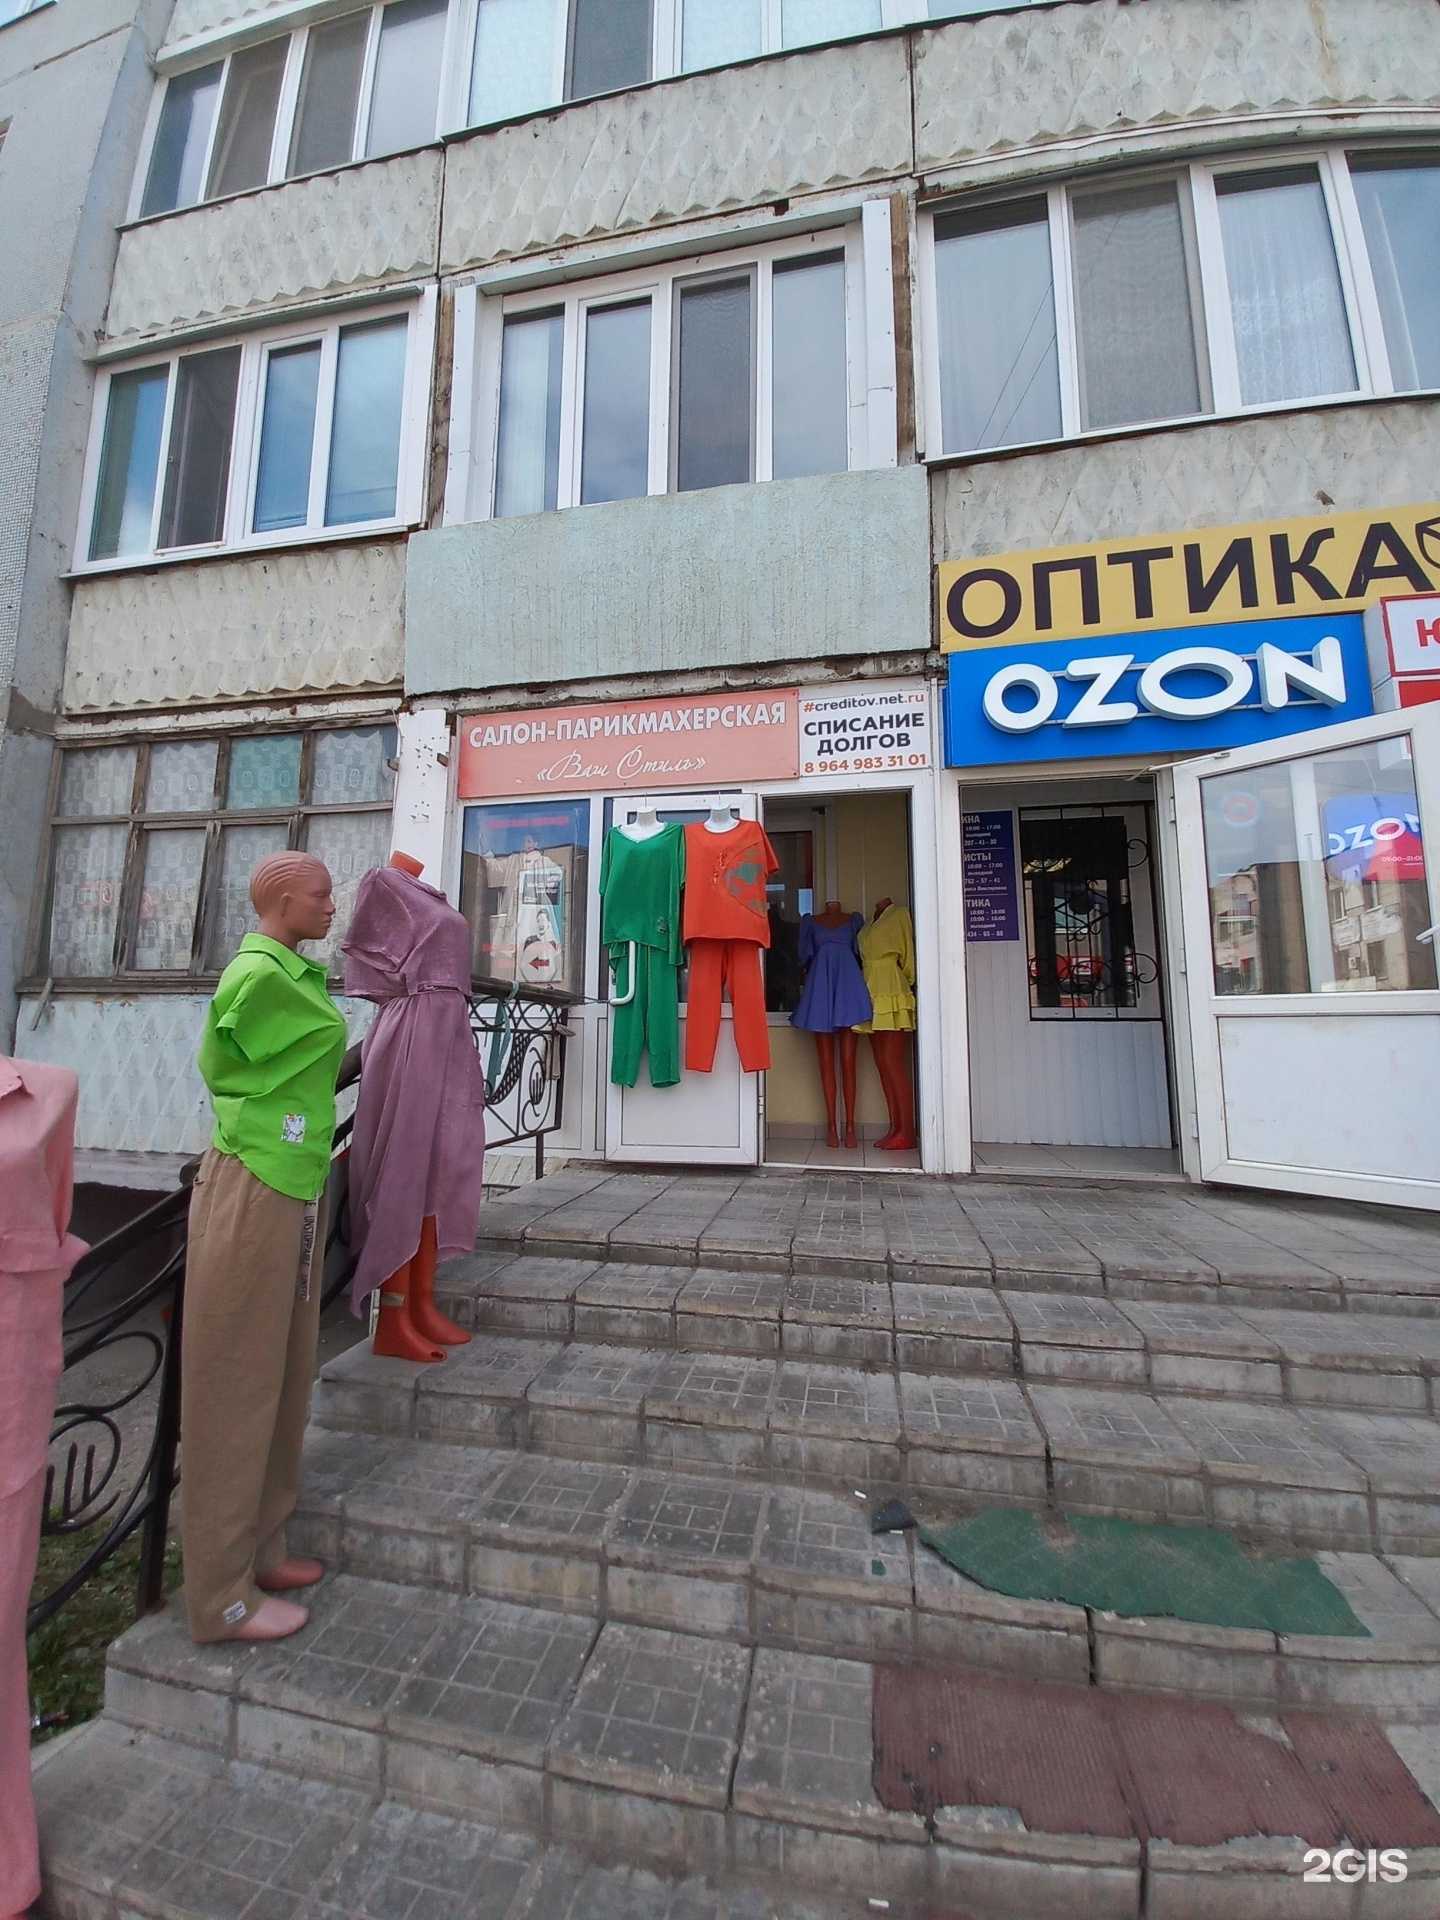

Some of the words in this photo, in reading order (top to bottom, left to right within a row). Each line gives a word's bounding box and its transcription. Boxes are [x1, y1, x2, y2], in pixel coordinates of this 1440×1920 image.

[946, 521, 1436, 639] ОПТИКА
[983, 635, 1347, 735] OZON
[803, 693, 924, 713] #creditov.net.ru
[469, 699, 786, 749] САЛОН-ПАРИКМАХЕРСКАЯ
[804, 712, 925, 736] СПИСАНИЕ
[817, 732, 911, 757] ДОЛГОВ
[804, 762, 814, 774] 8
[818, 759, 849, 772] 964
[853, 756, 883, 770] 983
[887, 755, 903, 767] 31
[908, 753, 926, 766] 01
